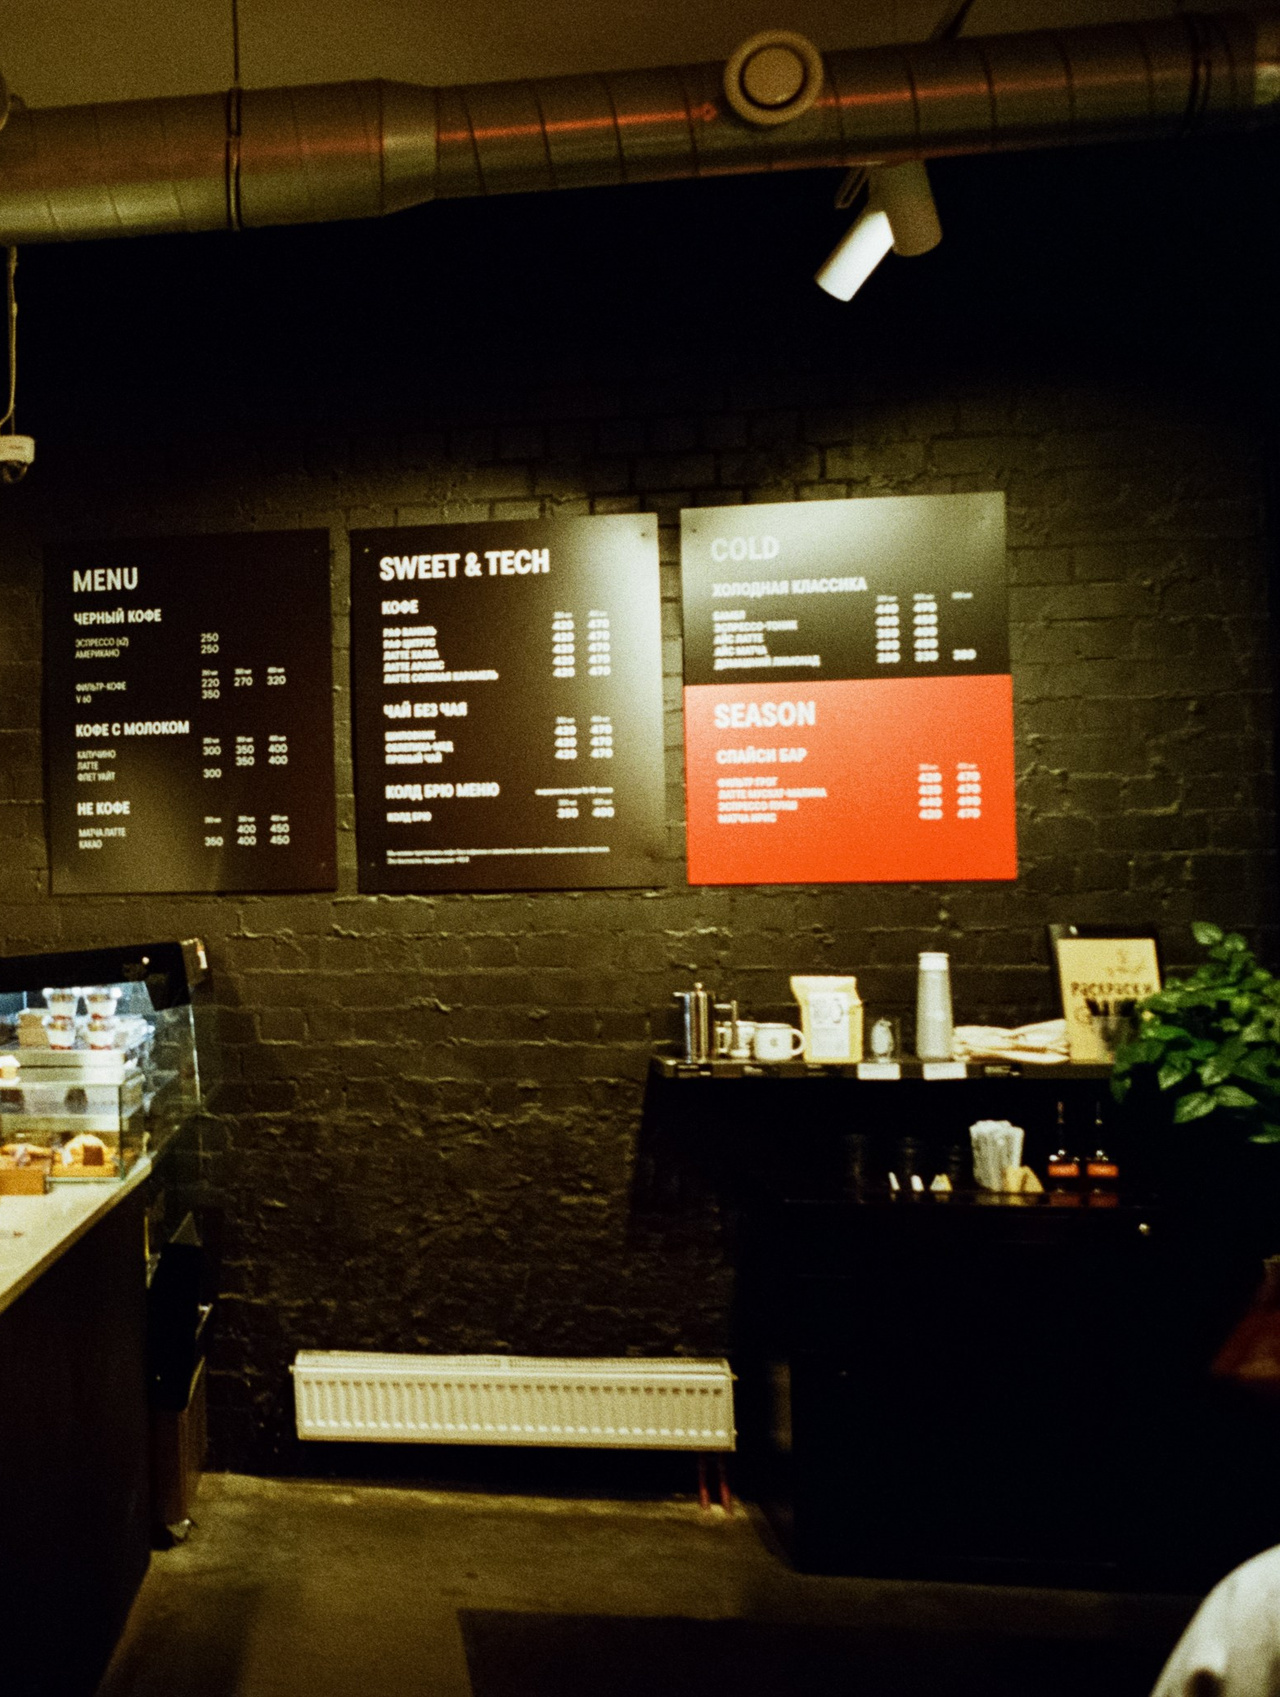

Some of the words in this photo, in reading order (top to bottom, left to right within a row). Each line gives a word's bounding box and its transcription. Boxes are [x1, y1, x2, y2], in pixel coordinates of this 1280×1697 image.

[710, 535, 780, 562] COLD
[379, 553, 460, 581] SWEET
[465, 552, 482, 577] &
[484, 549, 550, 576] TECH
[73, 567, 138, 592] MENU
[712, 580, 790, 599] ХОЛОДНАЯ
[790, 576, 868, 595] КЛАССИКА
[381, 600, 419, 615] КОФЕ
[74, 608, 124, 625] ЧЕРНЫЙ
[128, 608, 162, 623] КОФЕ
[200, 633, 219, 643] 250
[74, 649, 120, 659] АМЕРИКАНО
[200, 644, 219, 654] 250
[201, 678, 220, 688] 220
[234, 677, 253, 687] 270
[267, 675, 286, 686] 320
[75, 681, 127, 692] ФИЛЬТР-КОФЕ
[383, 701, 412, 718] ЧАЙ
[413, 703, 438, 718] БЕЗ
[440, 702, 467, 716] ЧАЯ
[714, 701, 816, 729] SEASON
[75, 723, 109, 737] КОФЕ
[111, 723, 121, 736] С
[124, 720, 190, 736] МОЛОКОМ
[203, 746, 221, 756] 300
[235, 745, 255, 755] 350
[268, 743, 288, 754] 400
[235, 756, 255, 766] 350
[268, 755, 288, 765] 400
[77, 761, 98, 771] ЛАТТЕ
[203, 768, 222, 779] 300
[385, 784, 422, 801] КОЛД
[423, 783, 454, 798] БРЮ
[456, 782, 500, 797] МЕНЮ
[77, 802, 94, 816] НЕ
[96, 801, 130, 815] КОФЕ
[237, 825, 256, 835] 400
[269, 823, 290, 834] 450
[78, 839, 103, 849] КАКАО
[237, 836, 256, 846] 400
[269, 835, 290, 845] 450
